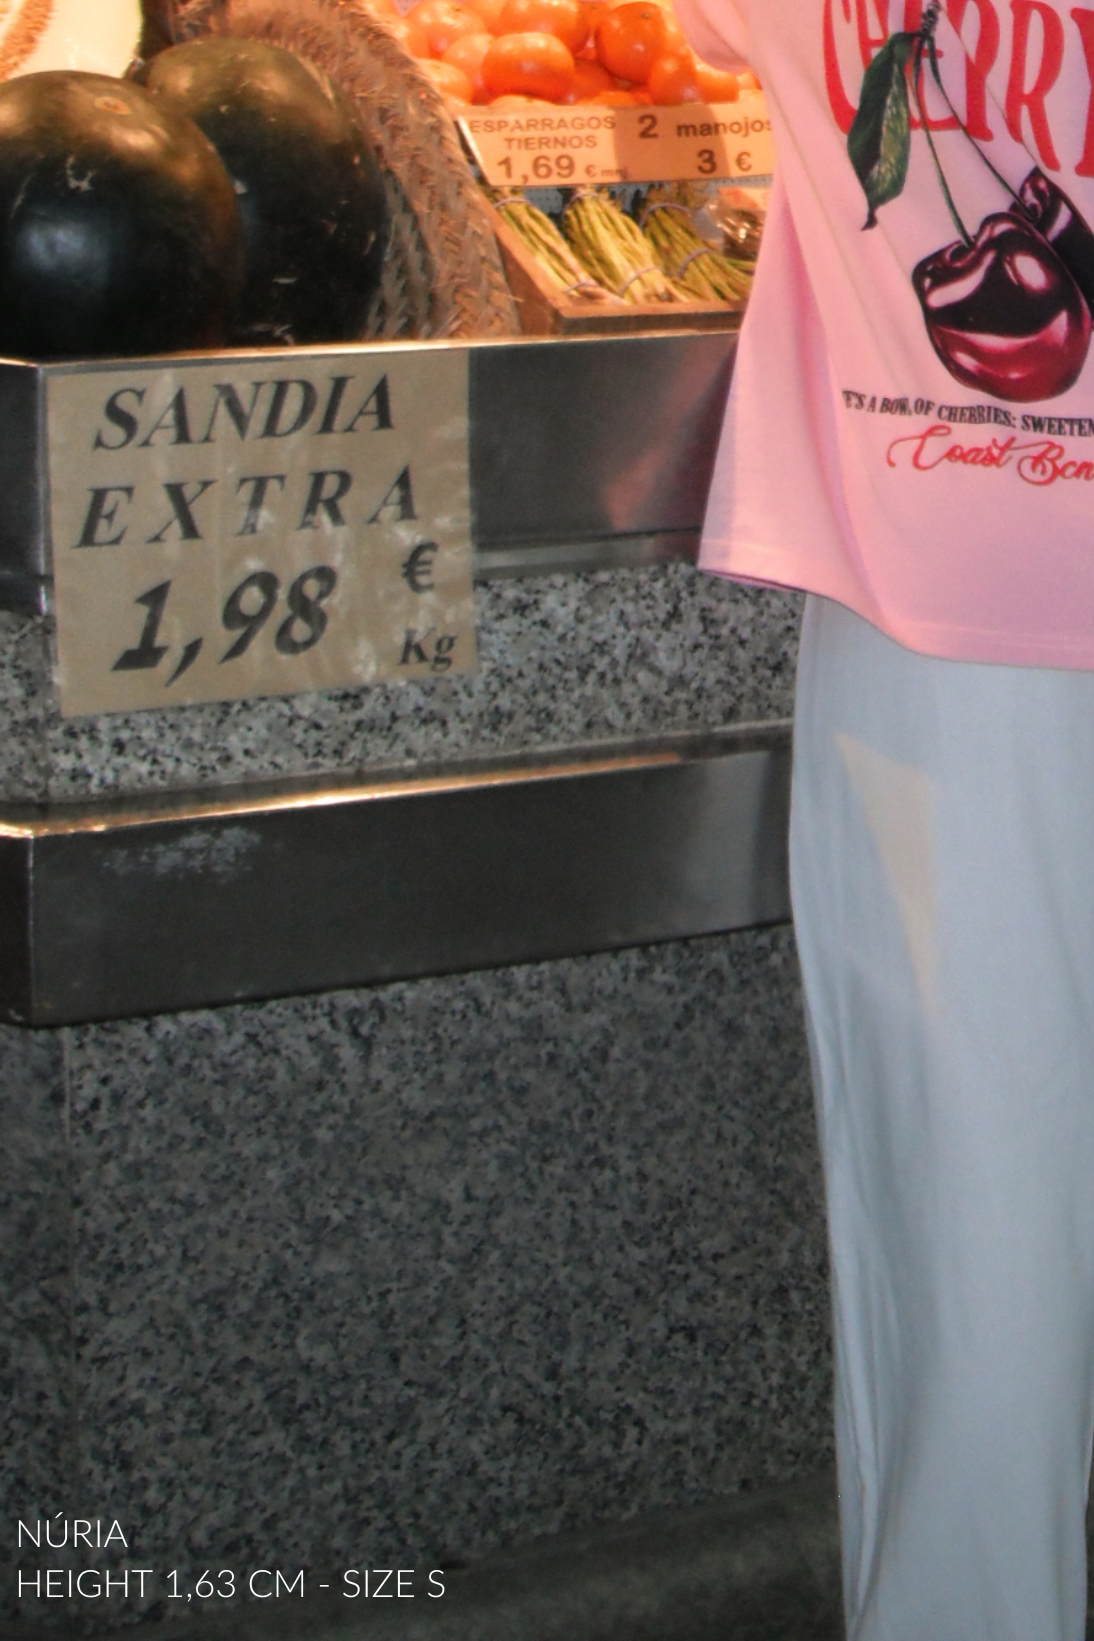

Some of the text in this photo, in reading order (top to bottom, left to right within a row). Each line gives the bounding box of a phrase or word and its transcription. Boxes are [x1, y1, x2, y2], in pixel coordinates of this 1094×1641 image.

[469, 115, 616, 133] ESPARRAGOS
[638, 113, 659, 139] 2
[503, 135, 598, 151] TIERNOS
[498, 153, 576, 185] 1,69
[697, 148, 752, 175] 3 €
[92, 373, 395, 451] SANDIA
[867, 395, 877, 414] A
[914, 397, 936, 416] OF
[886, 425, 1016, 471] Coast
[72, 464, 418, 549] EXTRA
[401, 541, 439, 594] €
[111, 565, 337, 688] 1,98
